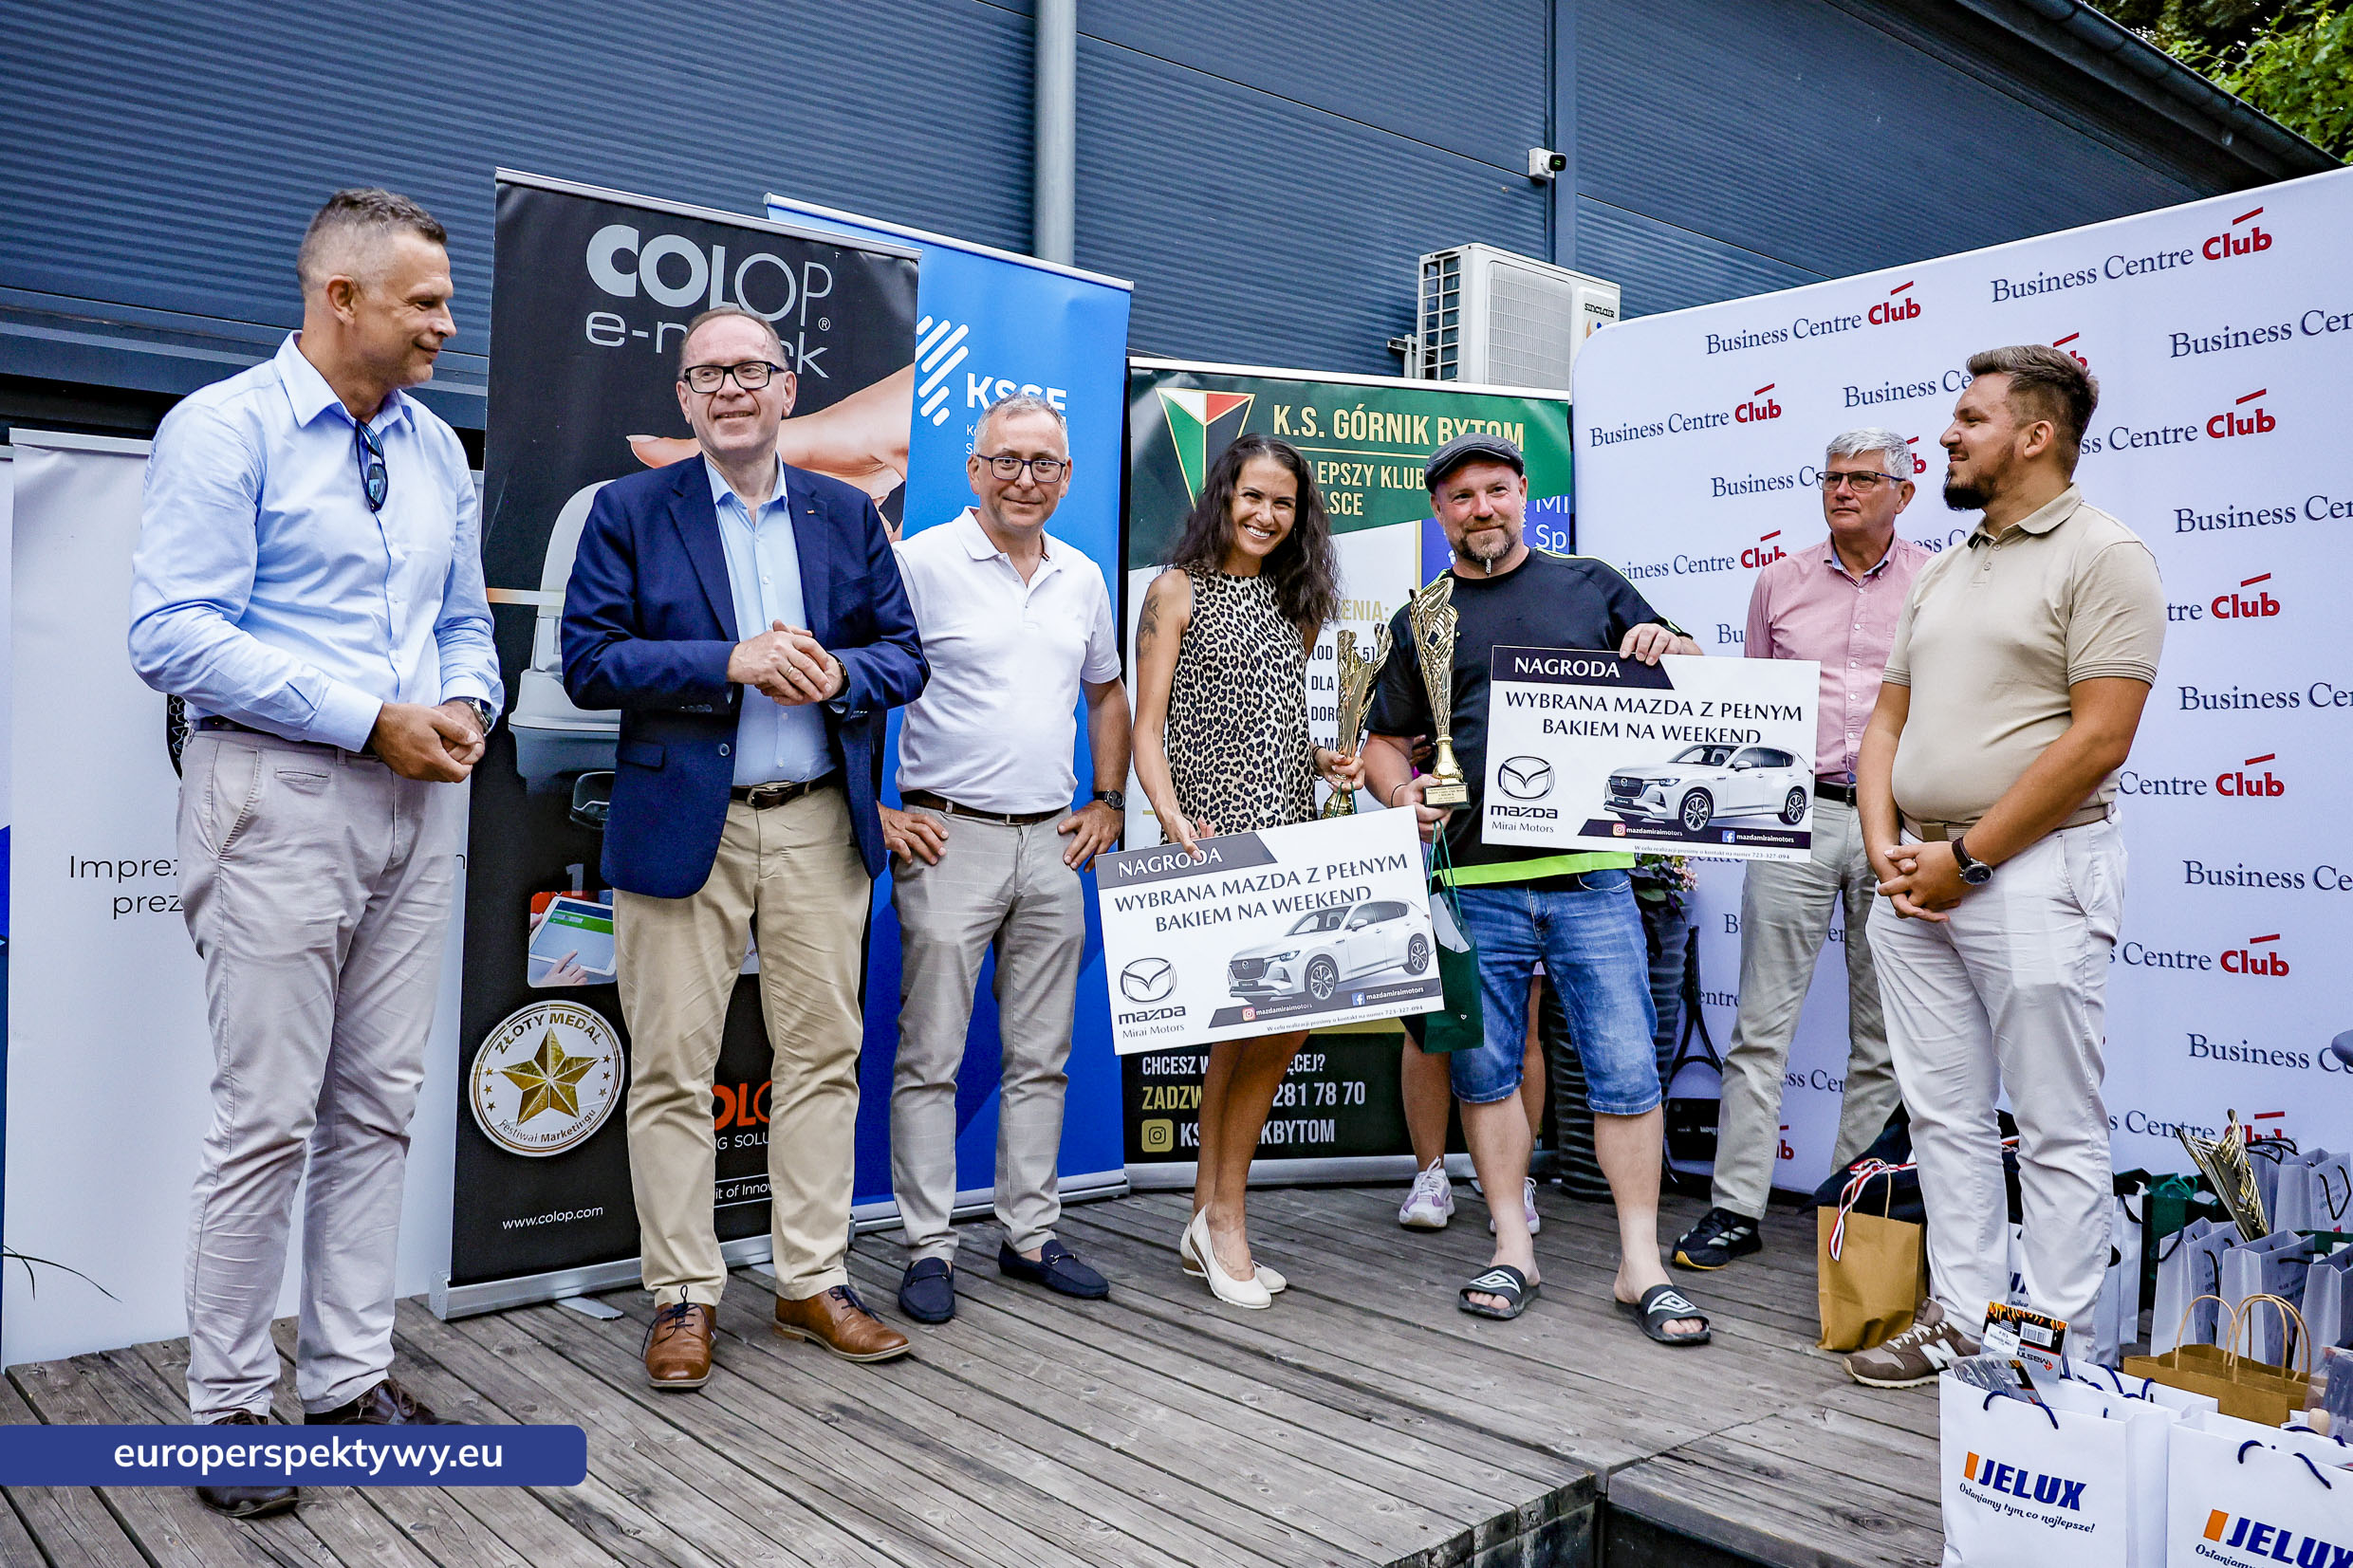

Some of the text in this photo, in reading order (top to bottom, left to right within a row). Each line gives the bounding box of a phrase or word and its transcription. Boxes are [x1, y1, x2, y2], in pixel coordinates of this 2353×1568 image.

[586, 224, 833, 326] COLOP
[1991, 227, 2272, 303] Business Centre Club
[1706, 297, 1921, 355] Business Centre Club
[2169, 325, 2292, 358] Business
[1843, 381, 1936, 408] Business
[1273, 404, 1325, 438] K.S.
[1333, 403, 1431, 446] GÓRNIK
[1589, 398, 1782, 447] Business Centre Club
[2109, 425, 2198, 451] Centre
[2206, 408, 2276, 439] Club
[1380, 465, 1426, 490] KLUB
[1712, 474, 1794, 497] Business
[2174, 505, 2297, 533] Business
[1674, 555, 1735, 575] Centre
[2211, 592, 2281, 619] Club
[1514, 656, 1621, 678] NAGRODA
[1311, 675, 1334, 691] DLA
[1506, 692, 1802, 722] WYBRANA MAZDA Z PEŁNYM
[2177, 686, 2301, 710] Business
[1543, 718, 1761, 744] BAKIEM NA WEEKEND
[2119, 771, 2285, 797] Centre Club
[1491, 805, 1558, 820] mazda
[1491, 821, 1554, 834] Mirai Motors
[1118, 847, 1223, 878] NAGRODA
[2182, 859, 2306, 889] Business
[1115, 853, 1408, 913] WYBRANA MAZDA Z PEŁNYM
[1156, 886, 1372, 932] BAKIEM NA WEEKEND
[2122, 942, 2213, 970] Centre
[2220, 950, 2289, 977] Club
[1119, 1005, 1186, 1025] mazda
[495, 1013, 602, 1055] ZŁOTY MEDAL
[1122, 1024, 1185, 1040] Mirai Motors
[2186, 1033, 2310, 1069] Business
[1141, 1056, 1197, 1076] CHCESZ
[1272, 1082, 1306, 1108] 281
[1313, 1081, 1338, 1106] 78
[1343, 1080, 1366, 1105] 70
[499, 1109, 597, 1143] Festiwal Marketingu
[727, 1184, 740, 1199] of
[502, 1205, 603, 1231] www.colop.com
[1978, 1458, 2087, 1511] JELUX
[2026, 1511, 2039, 1520] co
[2041, 1513, 2096, 1534] najlepsze!
